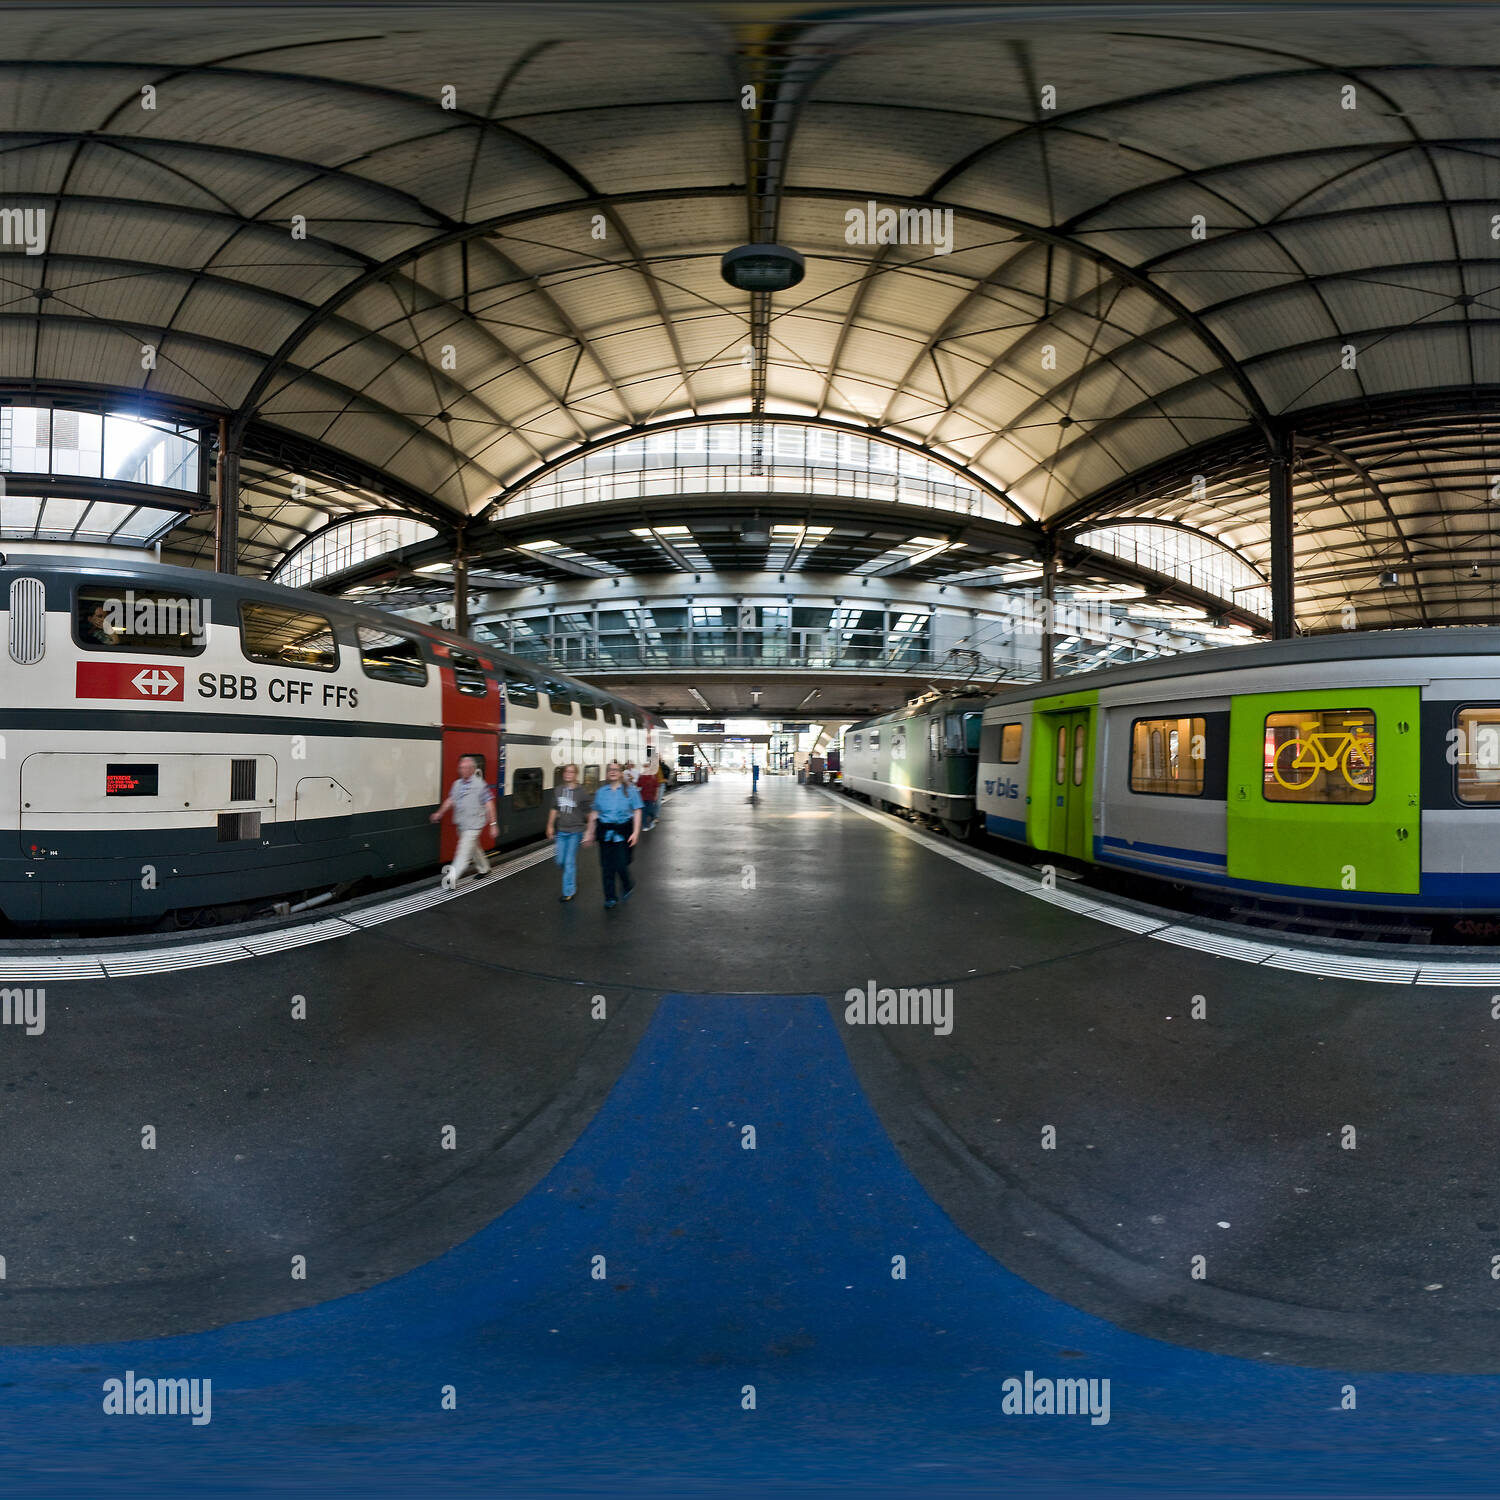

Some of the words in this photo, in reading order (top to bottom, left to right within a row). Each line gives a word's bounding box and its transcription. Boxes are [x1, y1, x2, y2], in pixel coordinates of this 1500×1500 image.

[198, 672, 257, 701] SBB
[268, 678, 313, 705] CFF
[323, 684, 359, 709] FFS
[997, 777, 1019, 799] bls
